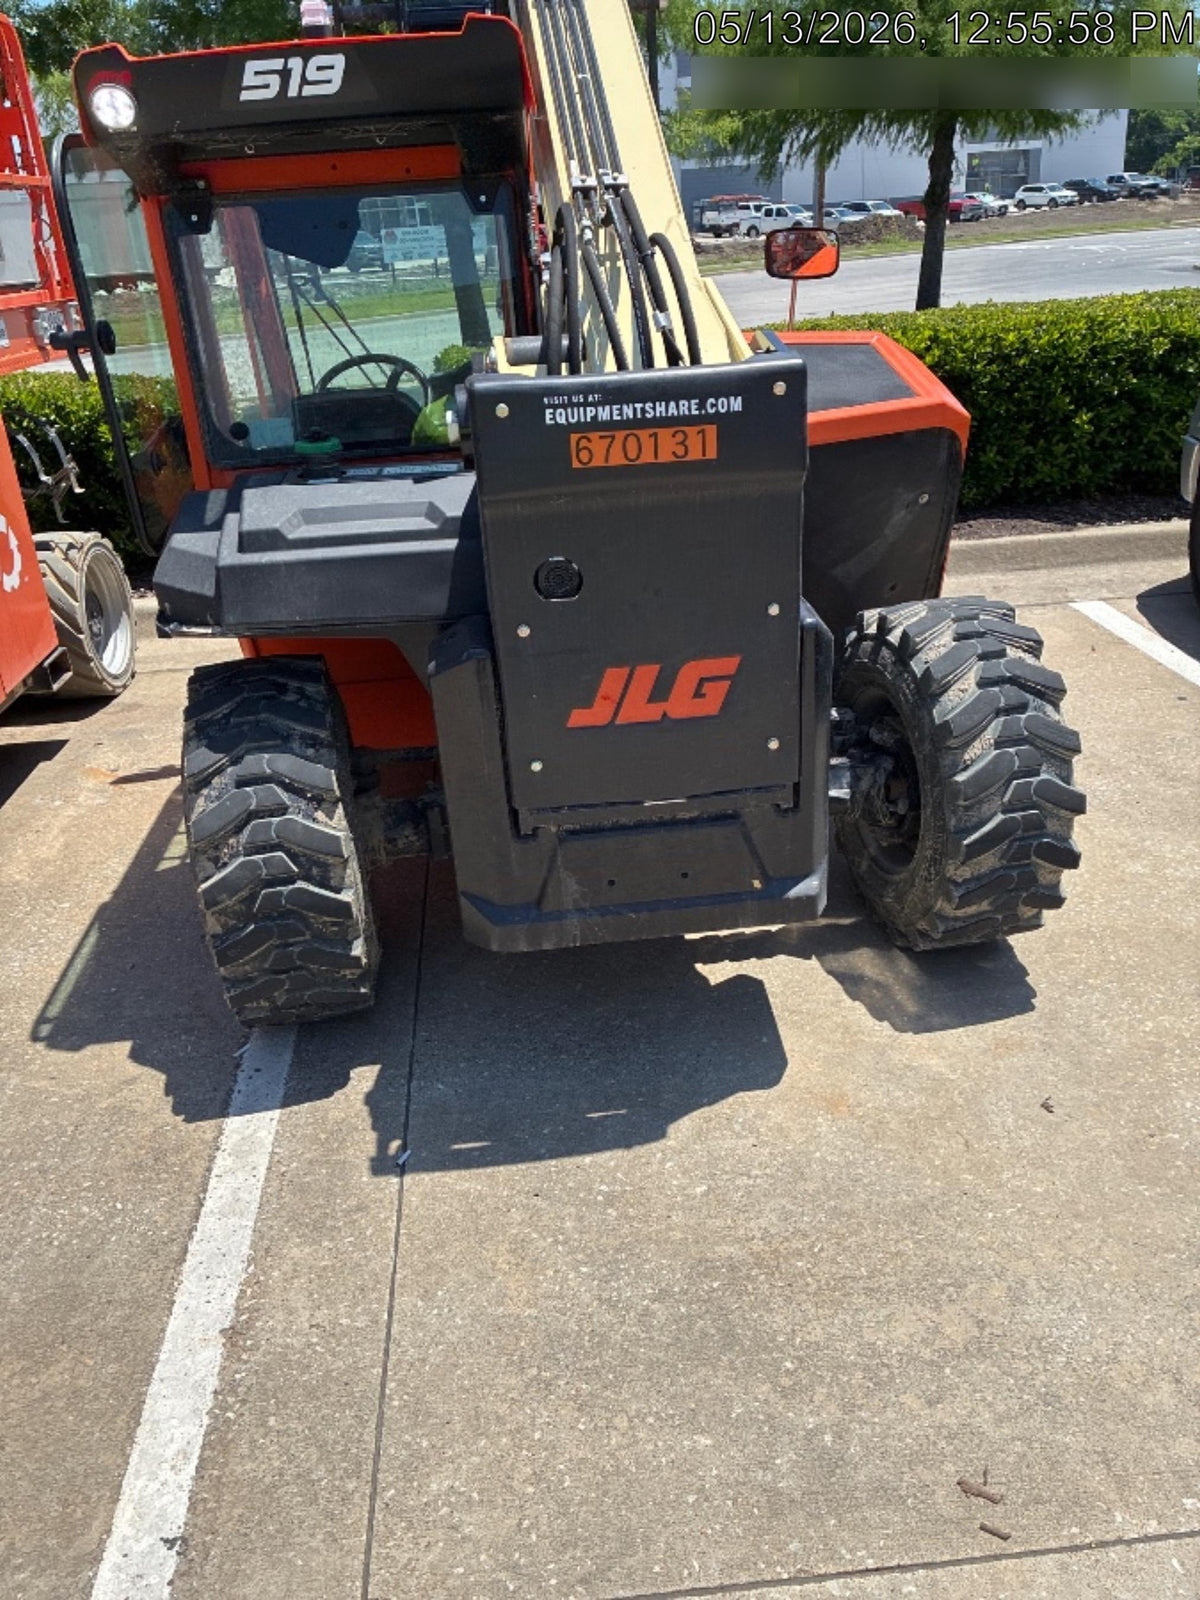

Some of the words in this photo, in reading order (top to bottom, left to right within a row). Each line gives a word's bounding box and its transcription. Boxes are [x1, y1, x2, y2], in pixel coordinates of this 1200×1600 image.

[239, 53, 346, 102] 519
[545, 396, 743, 425] EQUIPMENTSHARE.COM
[572, 394, 584, 403] US
[575, 428, 707, 466] 670131
[566, 655, 742, 728] JLG
